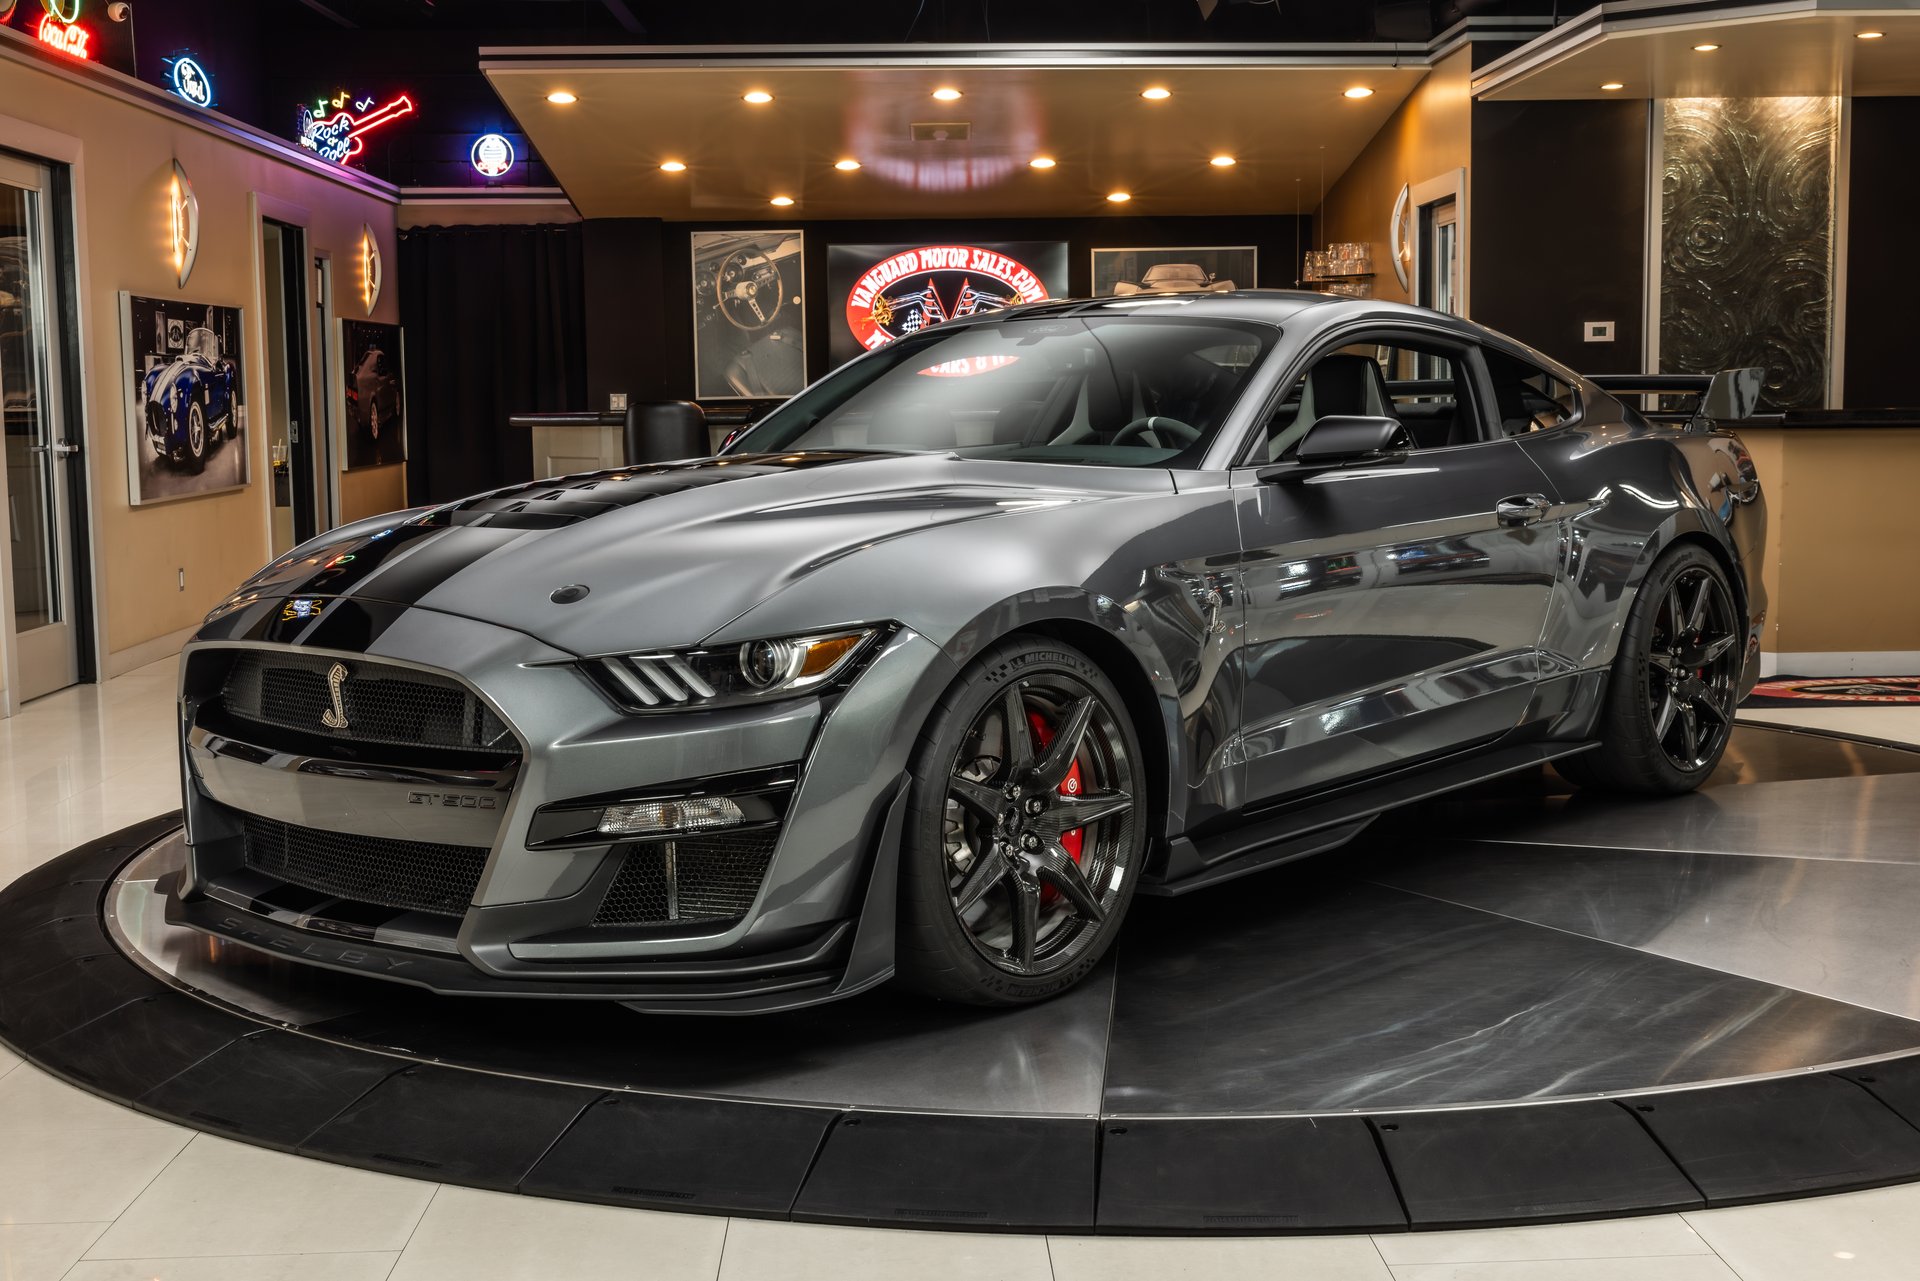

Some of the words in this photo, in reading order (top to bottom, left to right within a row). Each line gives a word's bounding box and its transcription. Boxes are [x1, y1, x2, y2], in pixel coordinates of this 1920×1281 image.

[181, 63, 205, 101] Ford
[311, 115, 349, 140] Rock
[851, 252, 918, 309] VANGUARD
[919, 248, 969, 269] MOTOR
[970, 249, 1044, 301] SALES.COM
[1024, 652, 1076, 667] MICHELIN
[408, 791, 496, 809] GT500
[217, 917, 413, 970] SHELBY
